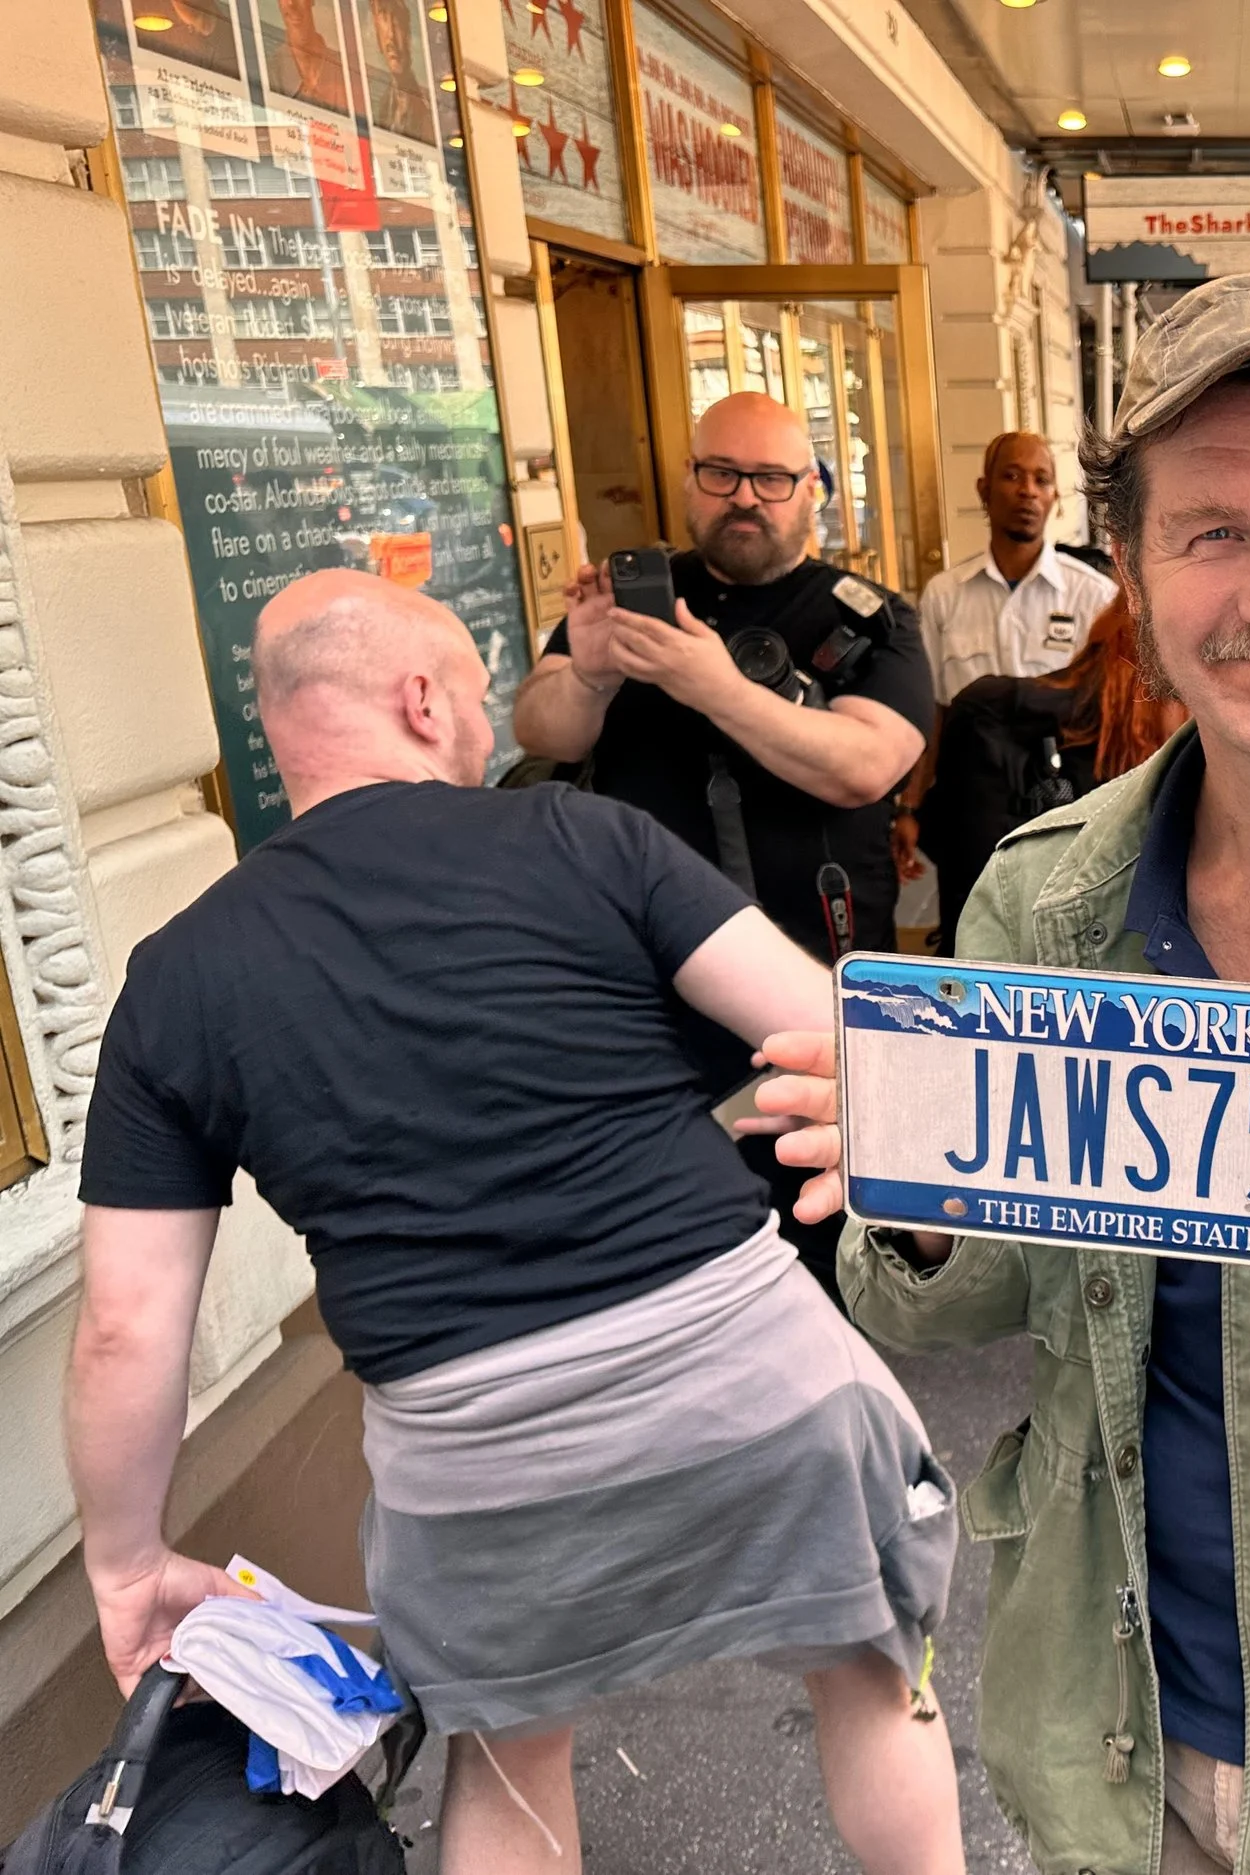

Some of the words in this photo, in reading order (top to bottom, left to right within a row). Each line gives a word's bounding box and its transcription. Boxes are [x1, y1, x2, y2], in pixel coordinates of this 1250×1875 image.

[155, 200, 223, 245] FADE
[268, 225, 297, 258] The
[163, 252, 181, 285] is
[172, 304, 236, 336] veteran
[179, 344, 251, 380] hotshots
[252, 351, 311, 383] Richard
[189, 402, 217, 423] are
[197, 447, 248, 475] mercy
[252, 435, 267, 468] of
[272, 435, 302, 469] foul
[205, 484, 262, 515] co-star.
[211, 526, 250, 559] flare
[255, 532, 277, 554] on
[280, 530, 292, 551] a
[219, 577, 238, 603] to
[975, 981, 1107, 1044] NEW
[978, 1198, 1040, 1230] THE
[1050, 1204, 1163, 1244] EMPIRE
